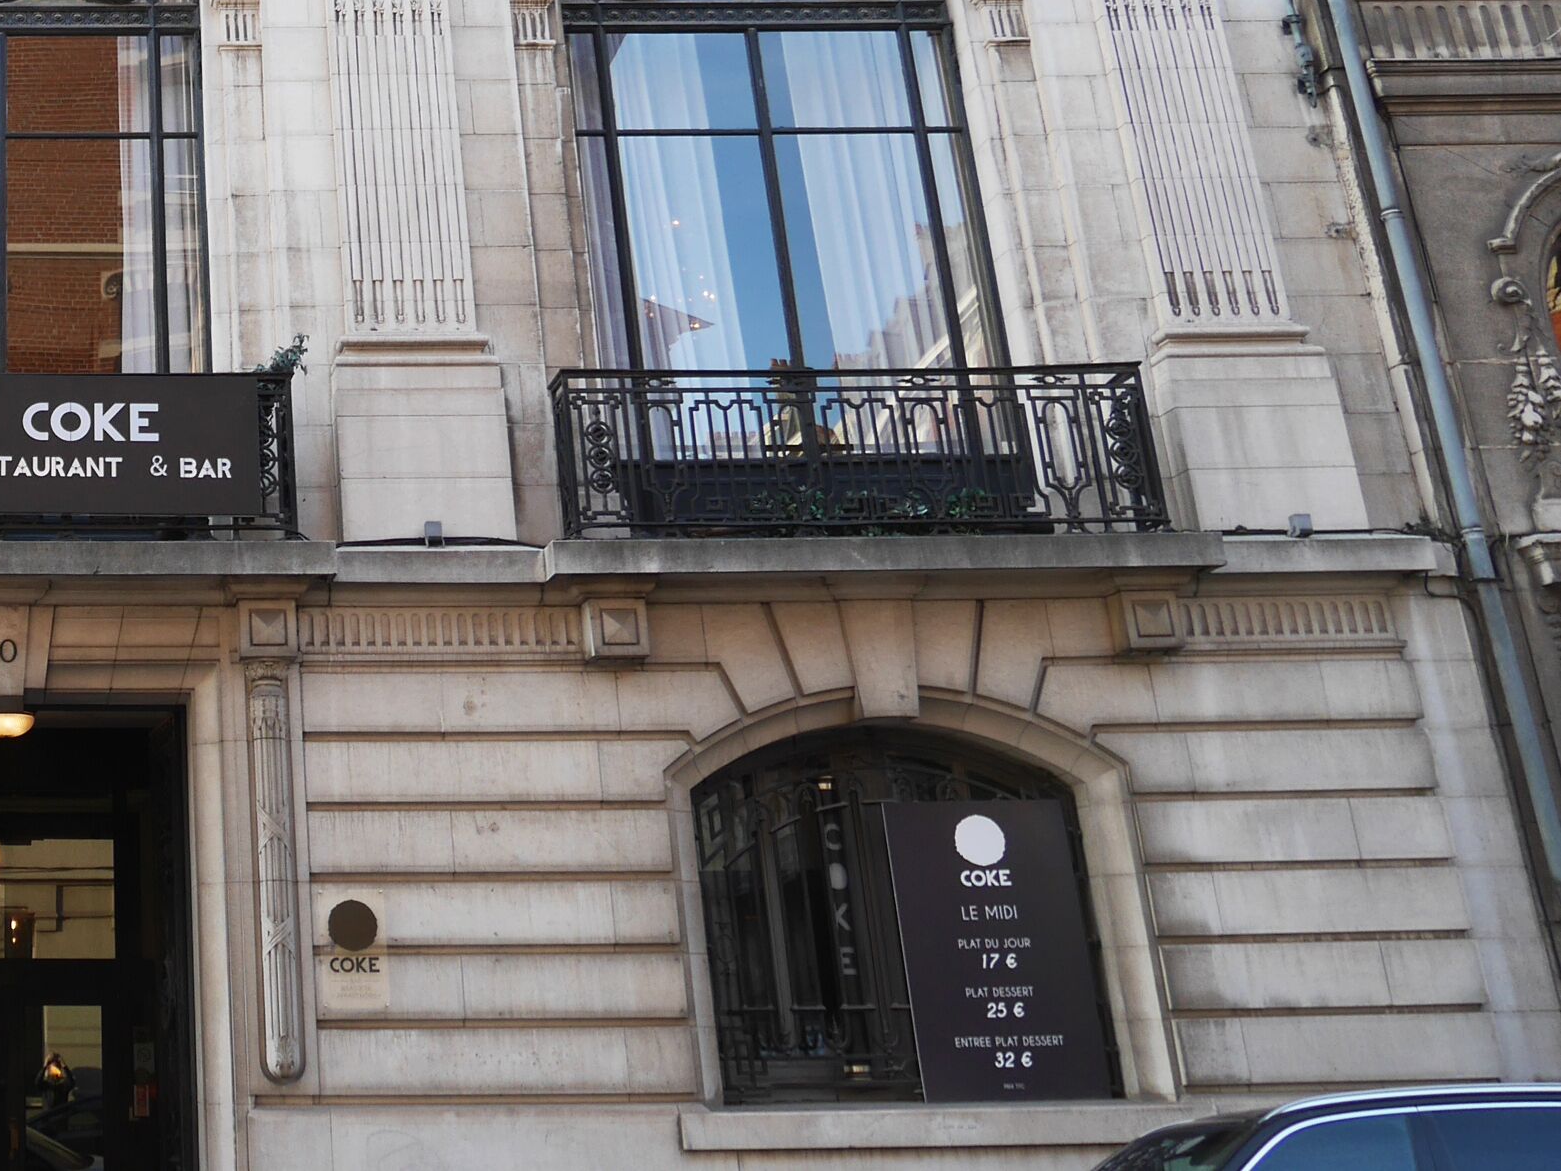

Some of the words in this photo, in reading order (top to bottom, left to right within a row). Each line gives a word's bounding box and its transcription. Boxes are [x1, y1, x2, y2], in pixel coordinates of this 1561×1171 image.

[22, 401, 161, 443] COKE
[149, 455, 169, 478] &
[179, 457, 233, 480] BAR
[959, 868, 1013, 888] COKE
[960, 905, 980, 922] LE
[984, 904, 1019, 921] MIDI
[957, 938, 982, 950] PLAT
[984, 938, 1000, 950] DU
[1003, 937, 1032, 949] JOUR
[329, 956, 381, 974] COKE
[981, 952, 1000, 970] 17
[1005, 952, 1018, 969] €
[964, 986, 989, 999] PLAT
[992, 985, 1034, 998] DESSERT
[986, 1001, 1008, 1019] 25
[1012, 1001, 1025, 1018] €
[954, 1036, 992, 1049] ENTREE
[994, 1035, 1019, 1048] PLAT
[1022, 1034, 1064, 1047] DESSERT
[994, 1051, 1015, 1069] 32
[1020, 1050, 1033, 1068] €
